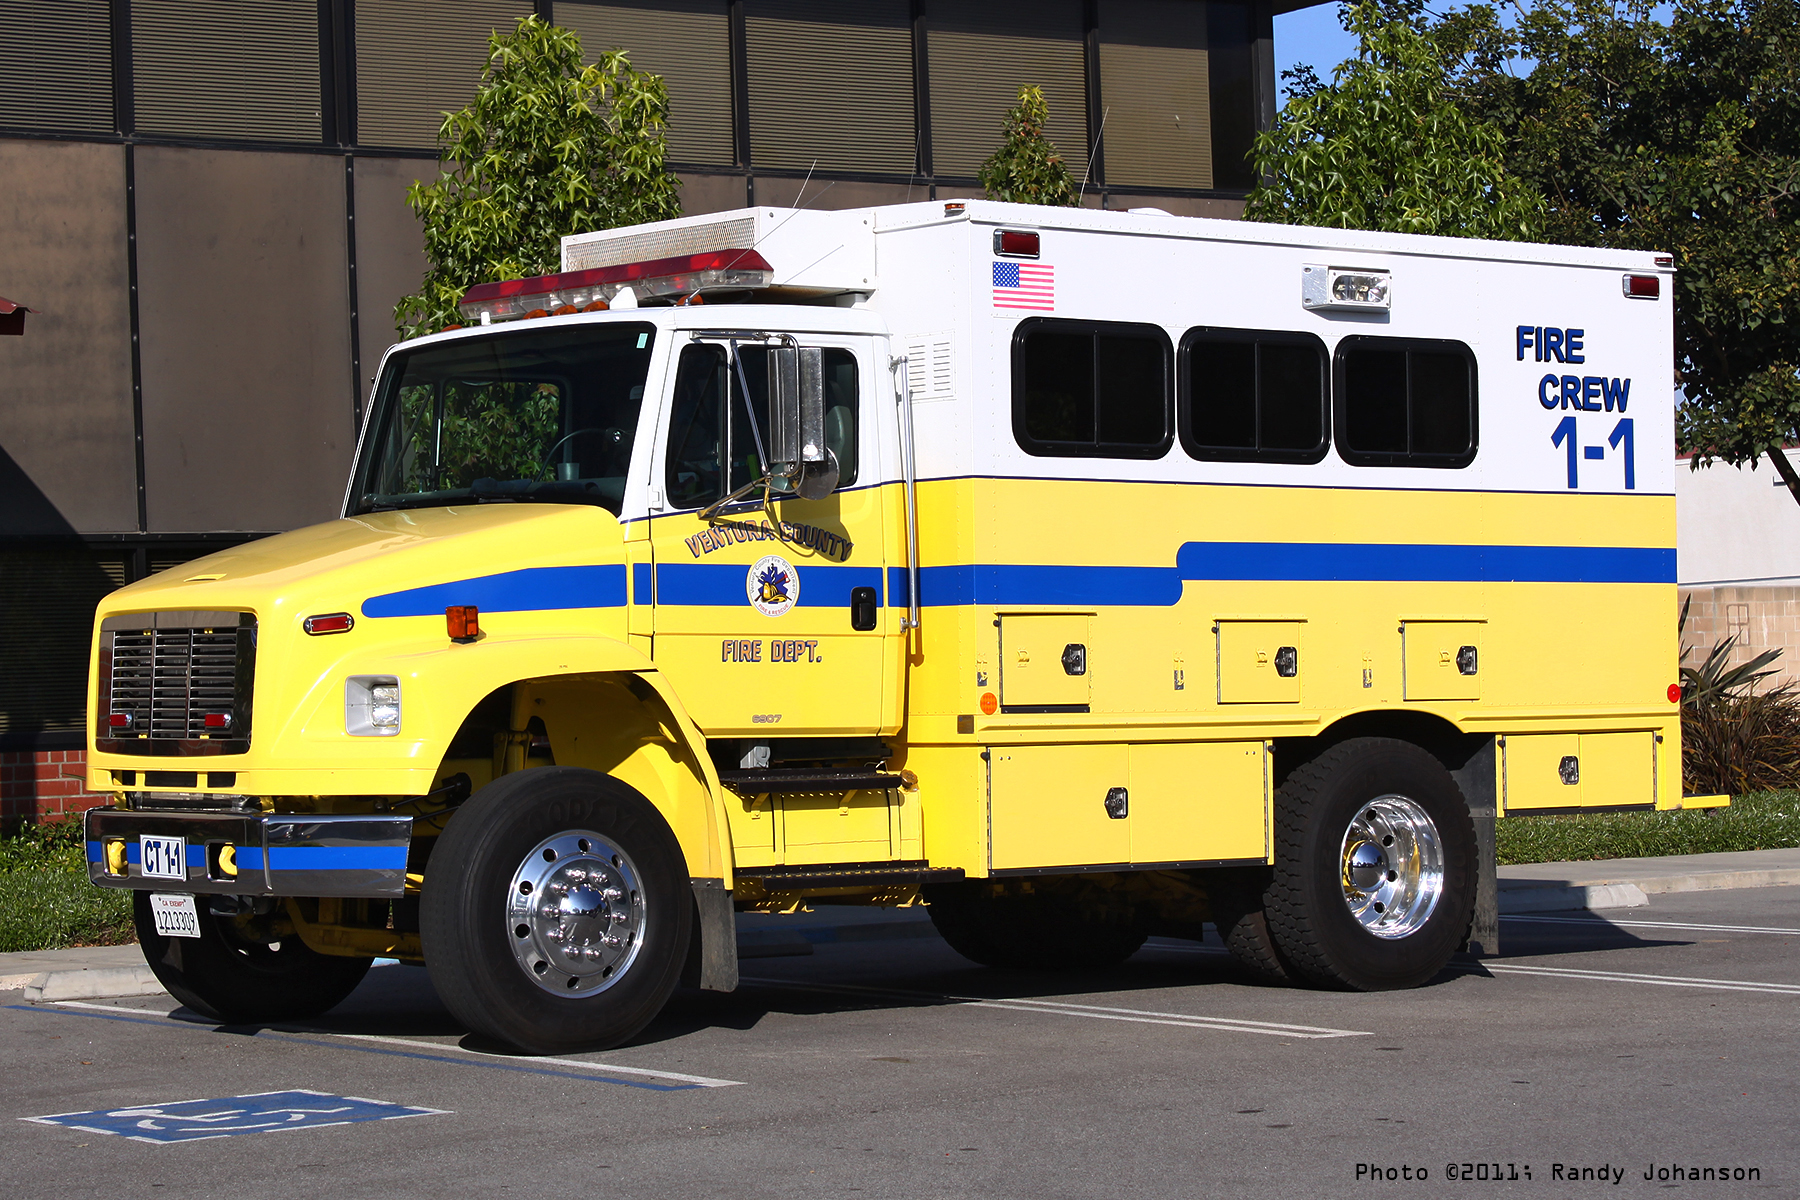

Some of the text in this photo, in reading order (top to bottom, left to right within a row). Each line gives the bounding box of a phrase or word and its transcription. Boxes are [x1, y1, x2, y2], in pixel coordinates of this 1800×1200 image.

[1516, 325, 1585, 364] FIRE
[1538, 373, 1631, 413] CREW
[1550, 416, 1635, 490] 1-1
[685, 520, 854, 562] VENTURA COUNTY
[755, 558, 770, 570] County
[722, 640, 822, 662] FIRE DEPT.
[144, 840, 181, 875] CT 1-1
[157, 910, 195, 931] 1213309
